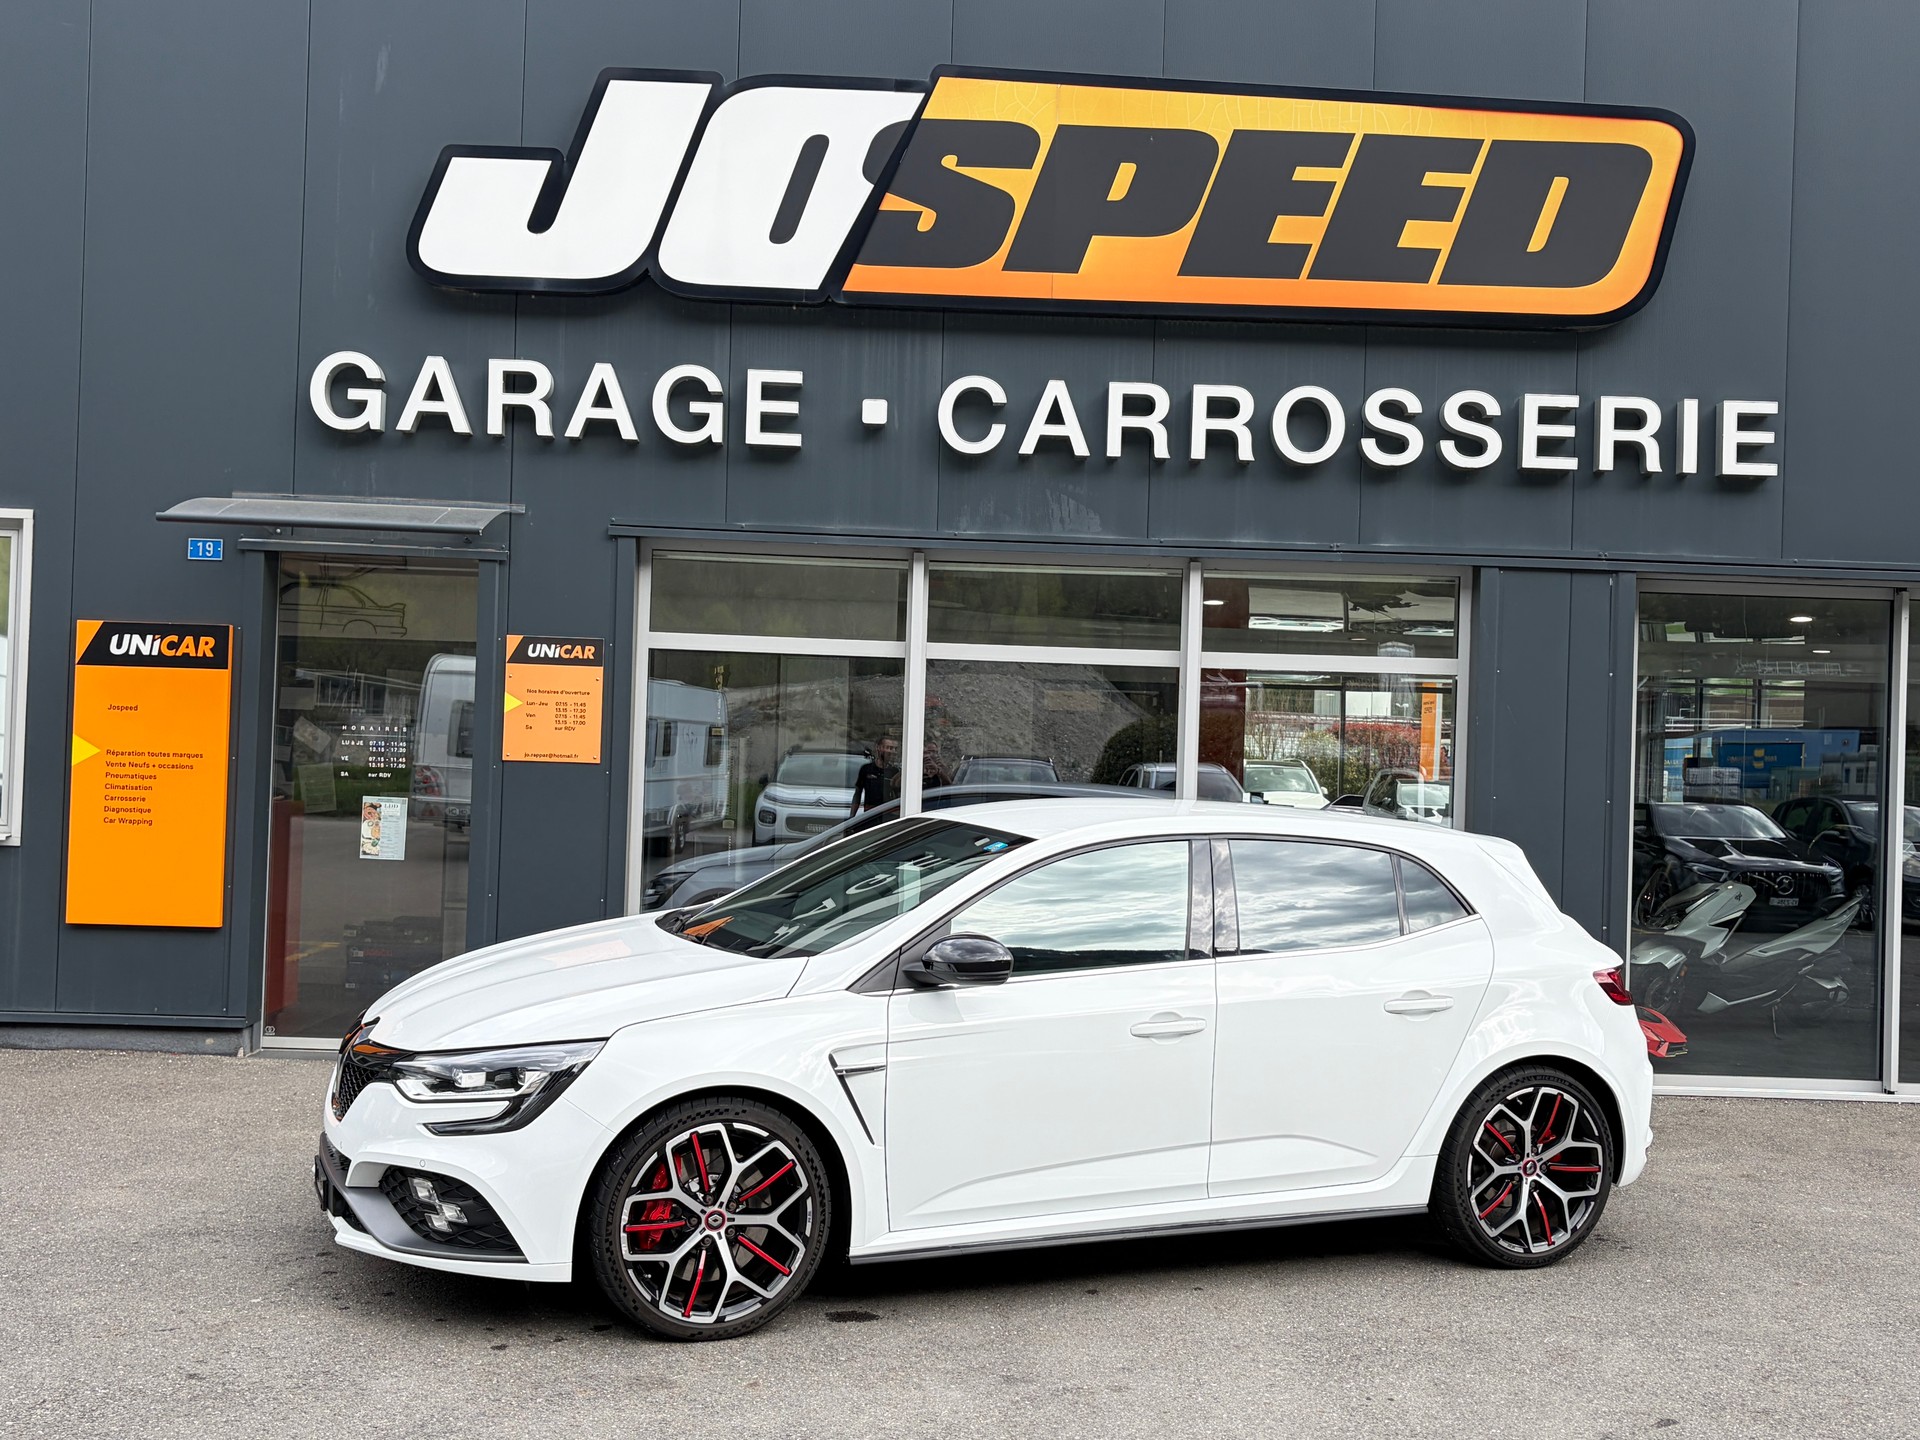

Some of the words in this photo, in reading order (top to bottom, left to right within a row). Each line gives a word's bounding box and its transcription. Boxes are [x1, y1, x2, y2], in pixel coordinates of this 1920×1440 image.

[418, 79, 1653, 290] JOSPEED
[309, 350, 804, 448] GARAGE
[937, 375, 1780, 479] CARROSSERIE
[197, 541, 214, 557] 19
[107, 703, 139, 712] Jospeed
[342, 725, 407, 733] HORAIRES
[106, 749, 146, 758] Réparation
[172, 752, 204, 760] marques
[105, 760, 127, 768] Vente
[128, 761, 150, 769] Neufs
[105, 771, 157, 781] Pneumatiques
[104, 783, 153, 791] Climatisation
[104, 794, 147, 802] Carrosserie
[103, 805, 152, 815] Diagnostique
[118, 817, 153, 827] Wrapping
